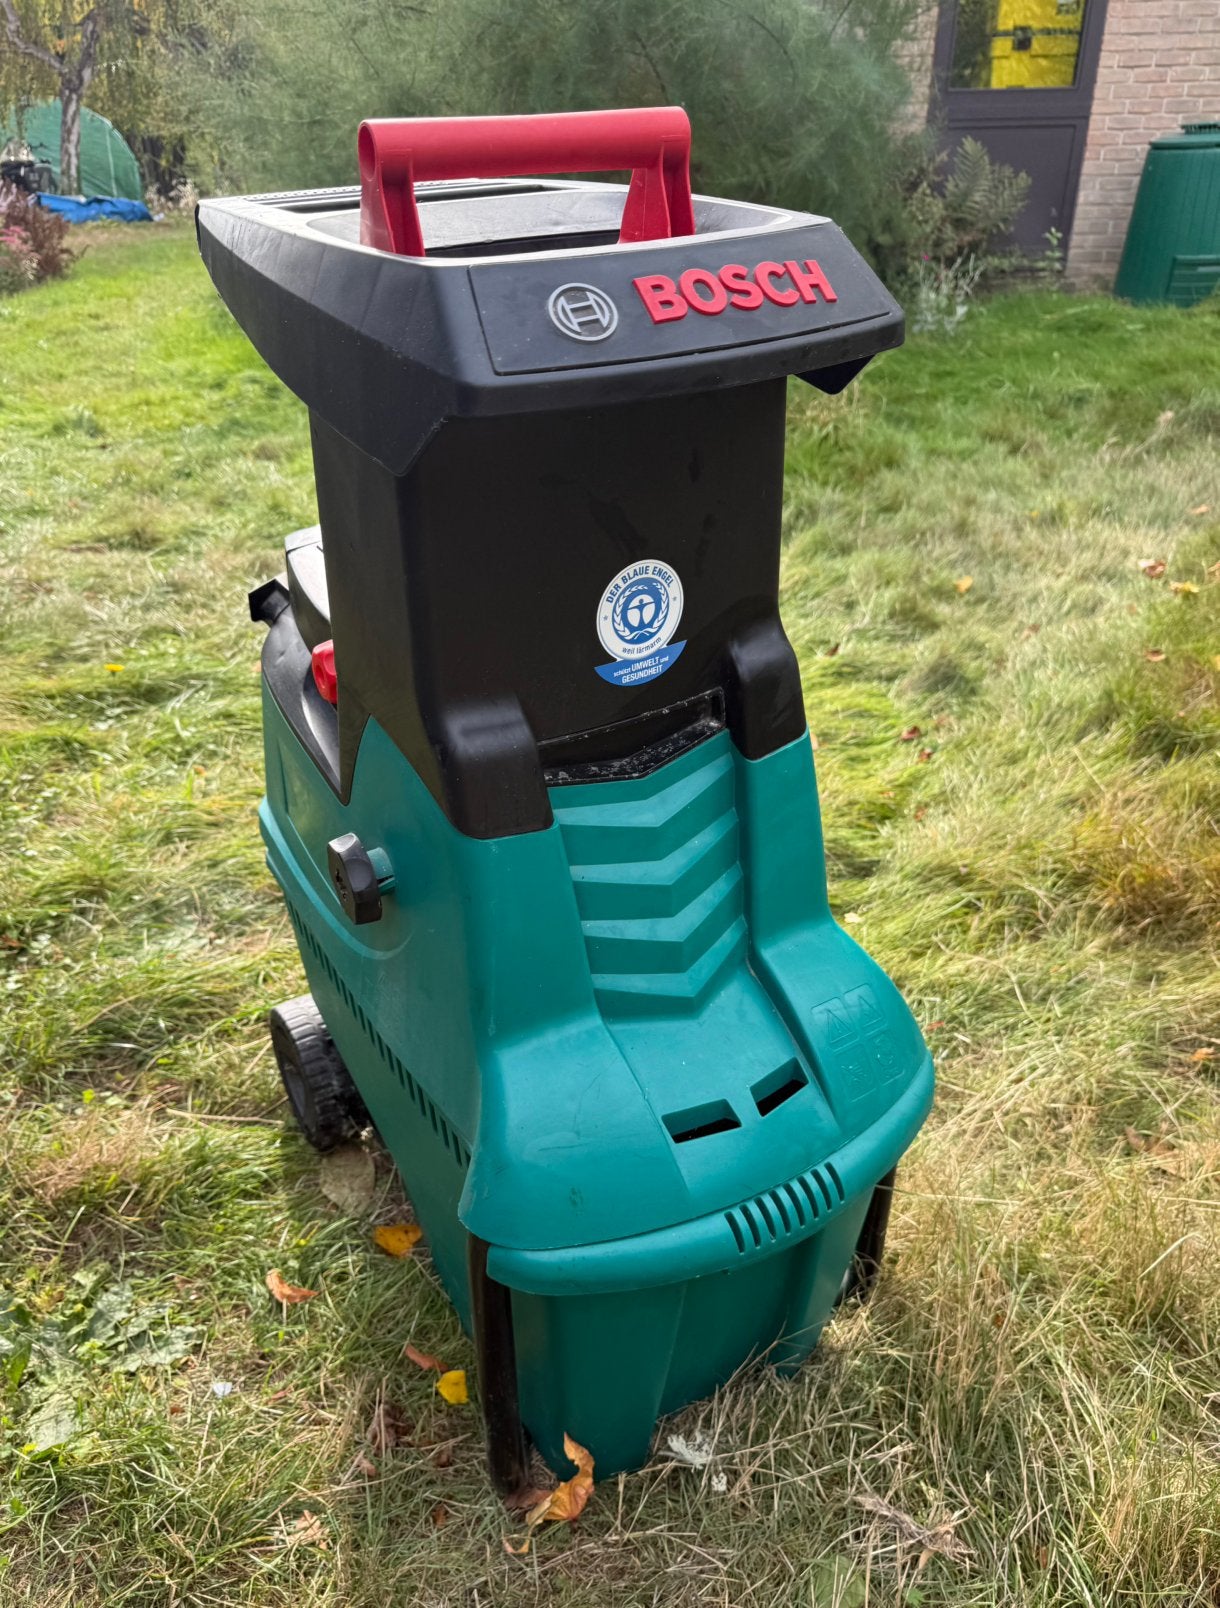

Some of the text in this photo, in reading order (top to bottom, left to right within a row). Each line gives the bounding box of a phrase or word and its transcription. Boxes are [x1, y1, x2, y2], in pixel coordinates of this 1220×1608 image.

[633, 260, 837, 324] BOSCH
[606, 566, 674, 603] DER BLAUE ENGEL
[622, 637, 662, 655] weil lärmarm
[613, 655, 669, 677] schützt UMWELT und
[622, 665, 663, 683] GESUNDHEIT
